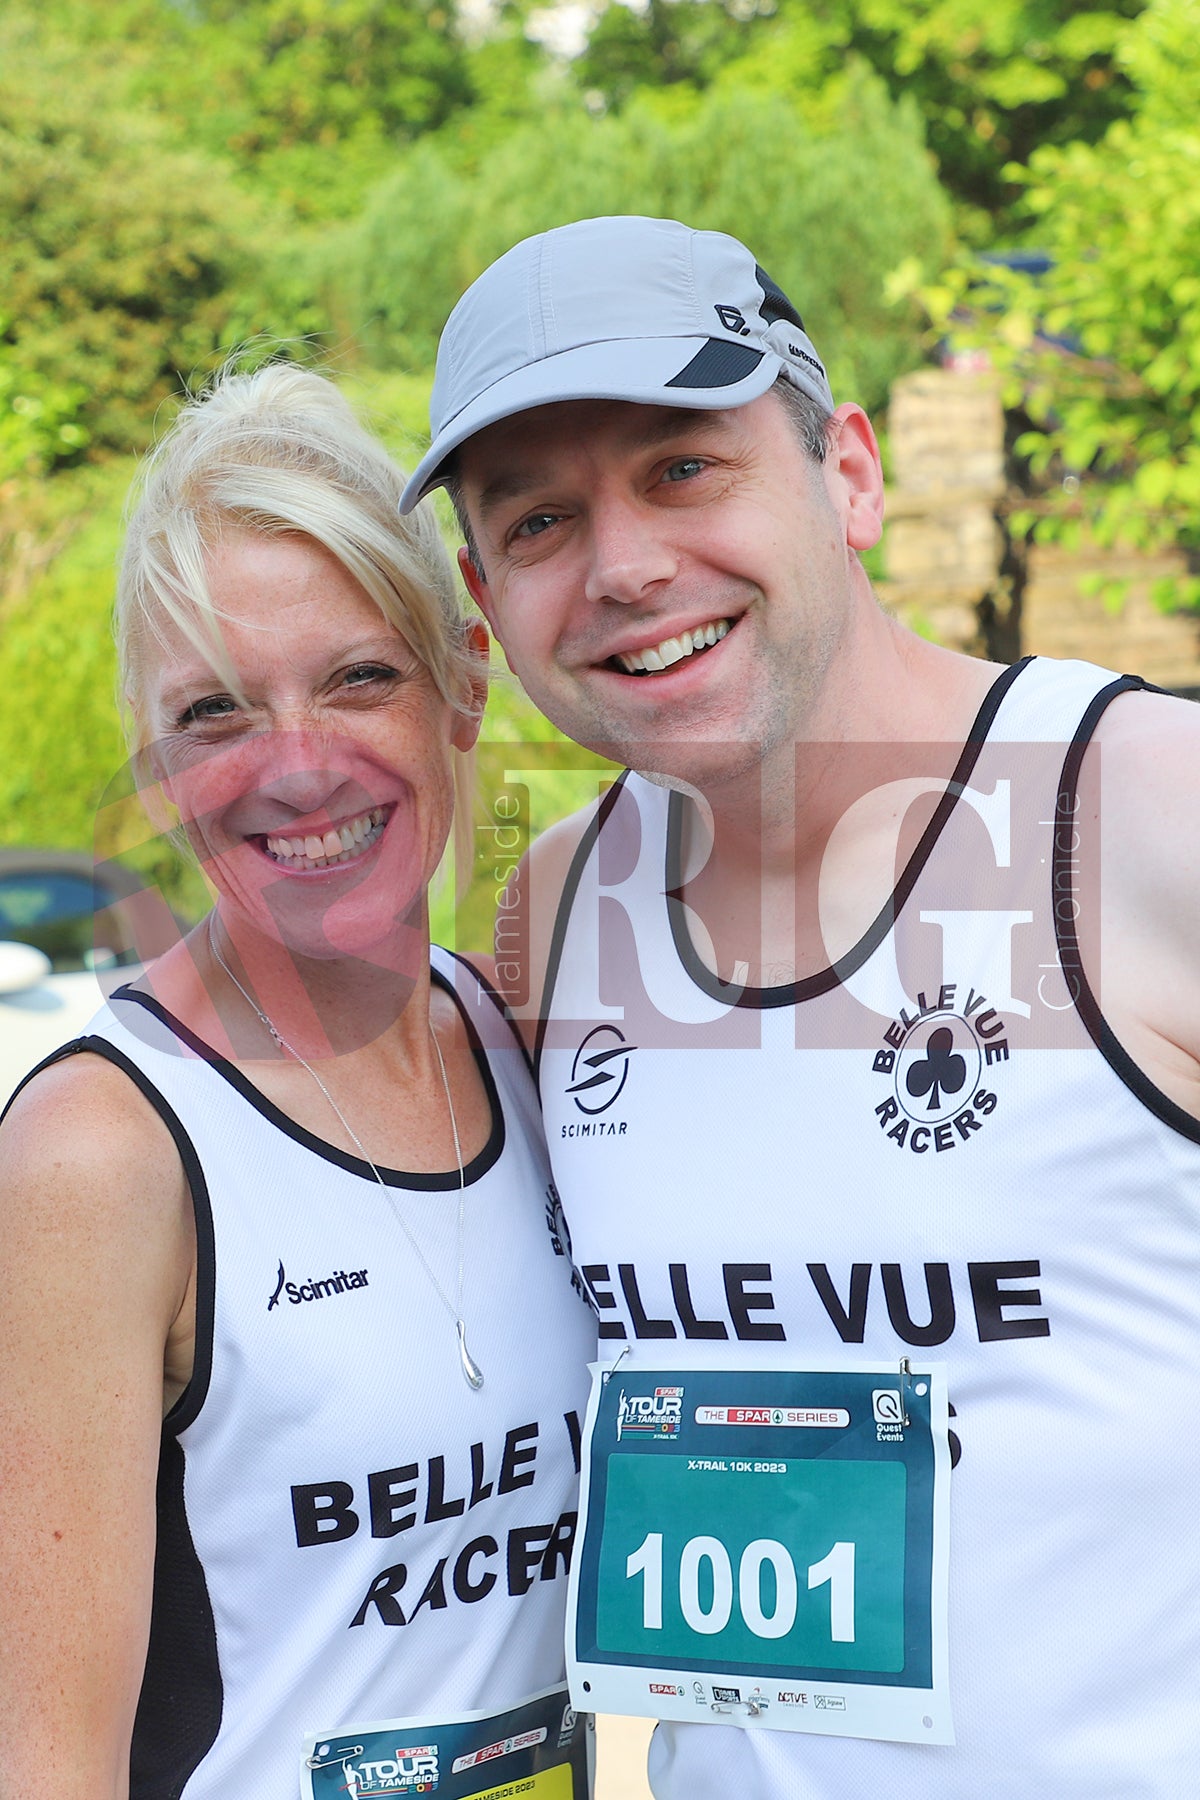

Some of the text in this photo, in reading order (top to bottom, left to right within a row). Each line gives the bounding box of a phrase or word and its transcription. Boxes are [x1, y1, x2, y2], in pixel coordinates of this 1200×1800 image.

[872, 983, 1010, 1074] BELLE VUE
[561, 1121, 628, 1139] SCIMITAR
[873, 1088, 998, 1154] RACERS
[285, 1268, 369, 1305] Scimitar
[581, 1262, 787, 1342] ELLE
[806, 1259, 1051, 1348] VUE
[629, 1396, 682, 1416] TOUR
[637, 1415, 682, 1424] TAMESIDE
[704, 1410, 839, 1423] THE SPAR SERIES
[876, 1423, 902, 1433] Quest
[876, 1432, 905, 1442] Events
[687, 1460, 787, 1474] X-TRAIL 10K 2023
[290, 1422, 540, 1548] BELLE
[347, 1511, 579, 1629] RACER
[626, 1532, 856, 1643] 1001
[650, 1684, 677, 1695] SPAR
[459, 1755, 475, 1769] THE
[480, 1742, 505, 1761] SPAR
[513, 1731, 541, 1748] SERIES
[358, 1755, 439, 1781] TOUR
[360, 1773, 440, 1791] OF TAMESIDE
[474, 1780, 536, 1800] MESIDE 2023
